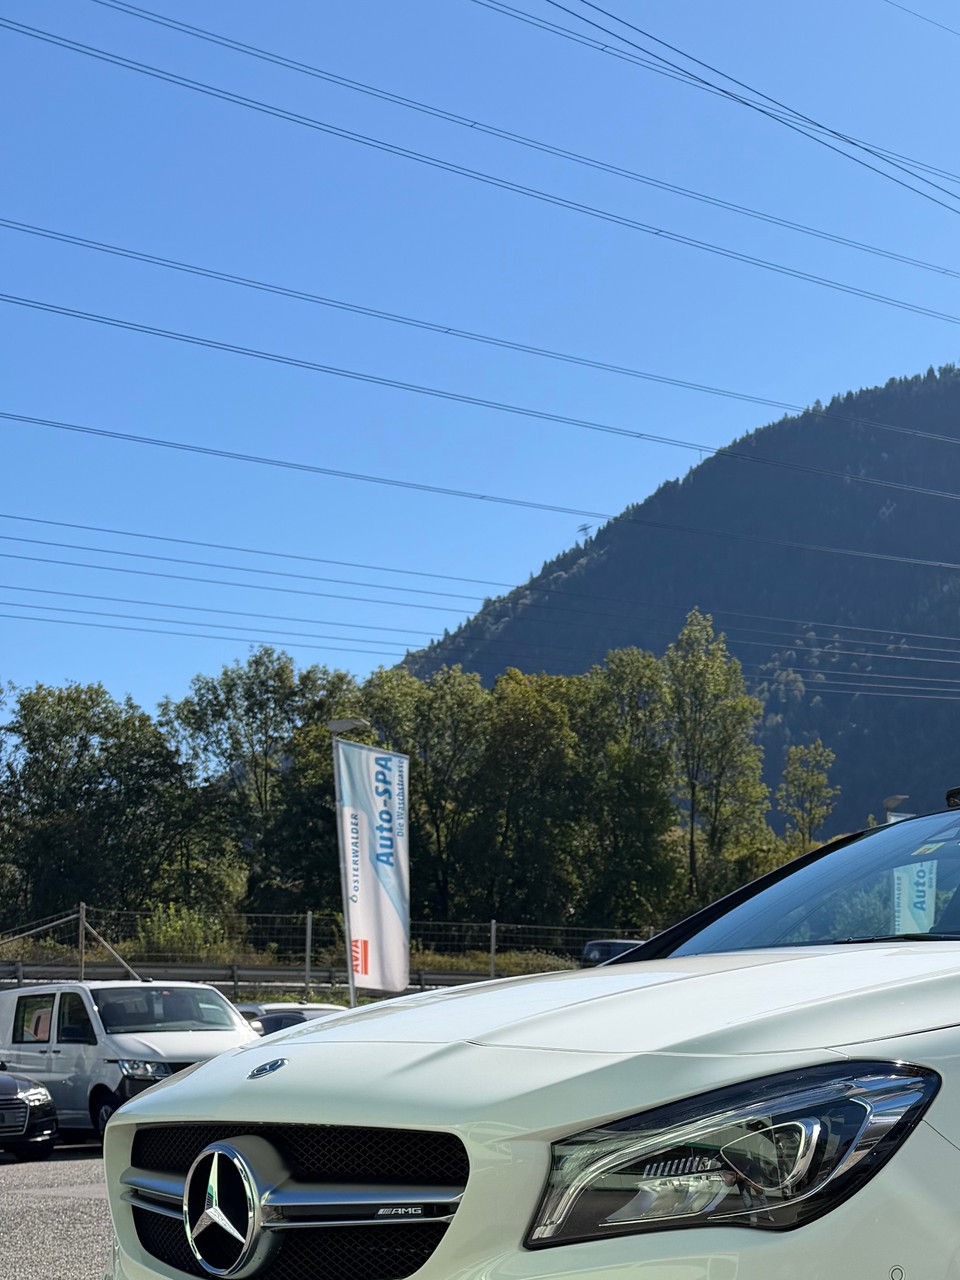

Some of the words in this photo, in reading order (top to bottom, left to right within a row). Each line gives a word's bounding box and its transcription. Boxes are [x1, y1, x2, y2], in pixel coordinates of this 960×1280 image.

[375, 756, 394, 868] Auto-SPA
[396, 822, 404, 837] Die
[350, 813, 359, 892] OSTERWALDER
